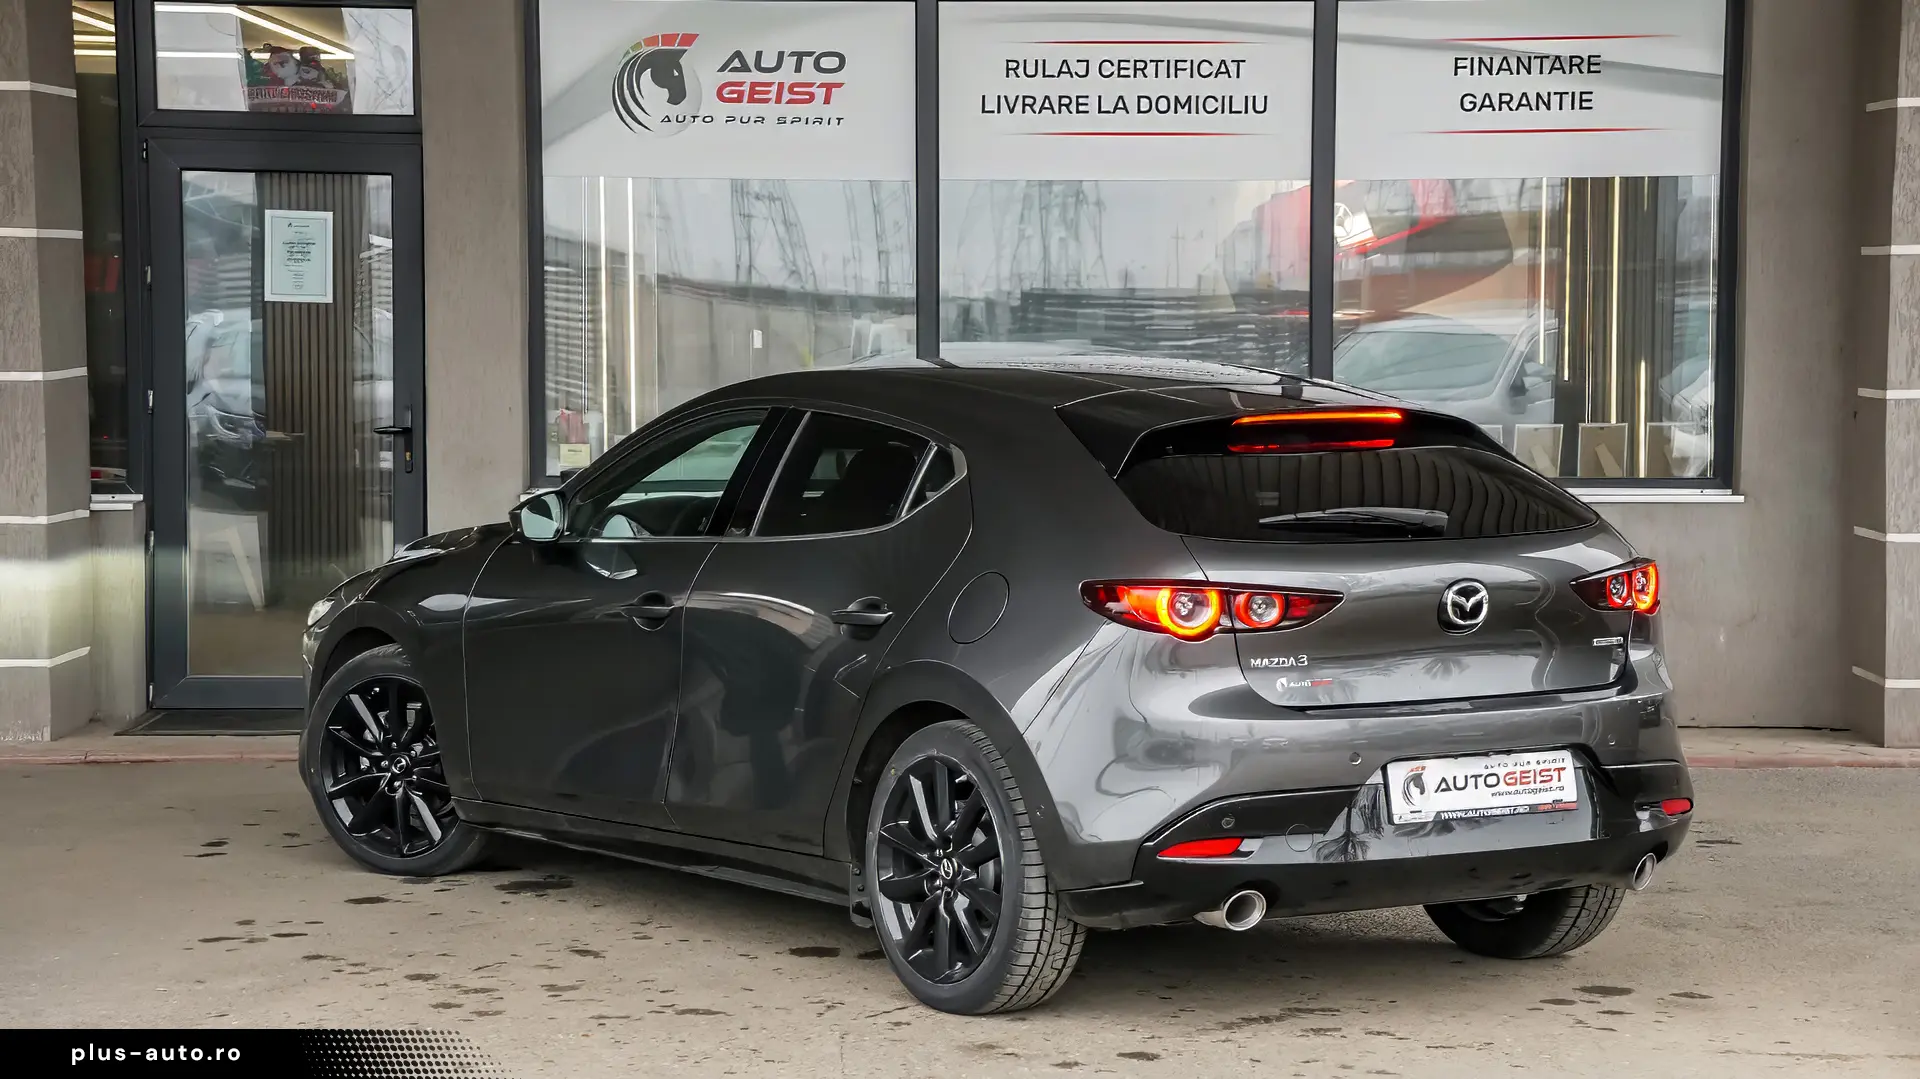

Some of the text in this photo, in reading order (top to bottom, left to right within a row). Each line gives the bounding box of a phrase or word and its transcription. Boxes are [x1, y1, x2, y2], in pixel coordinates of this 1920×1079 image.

[717, 49, 847, 74] AUTO
[1005, 59, 1246, 79] RULAJ CERTIFICAT
[1453, 54, 1602, 76] FINANTARE
[716, 81, 846, 105] GEIST
[1459, 91, 1594, 113] GARANTIE
[981, 95, 1269, 115] LIVRARE LA DOMICILIU
[660, 114, 845, 126] AUTO PUR SPIRIT
